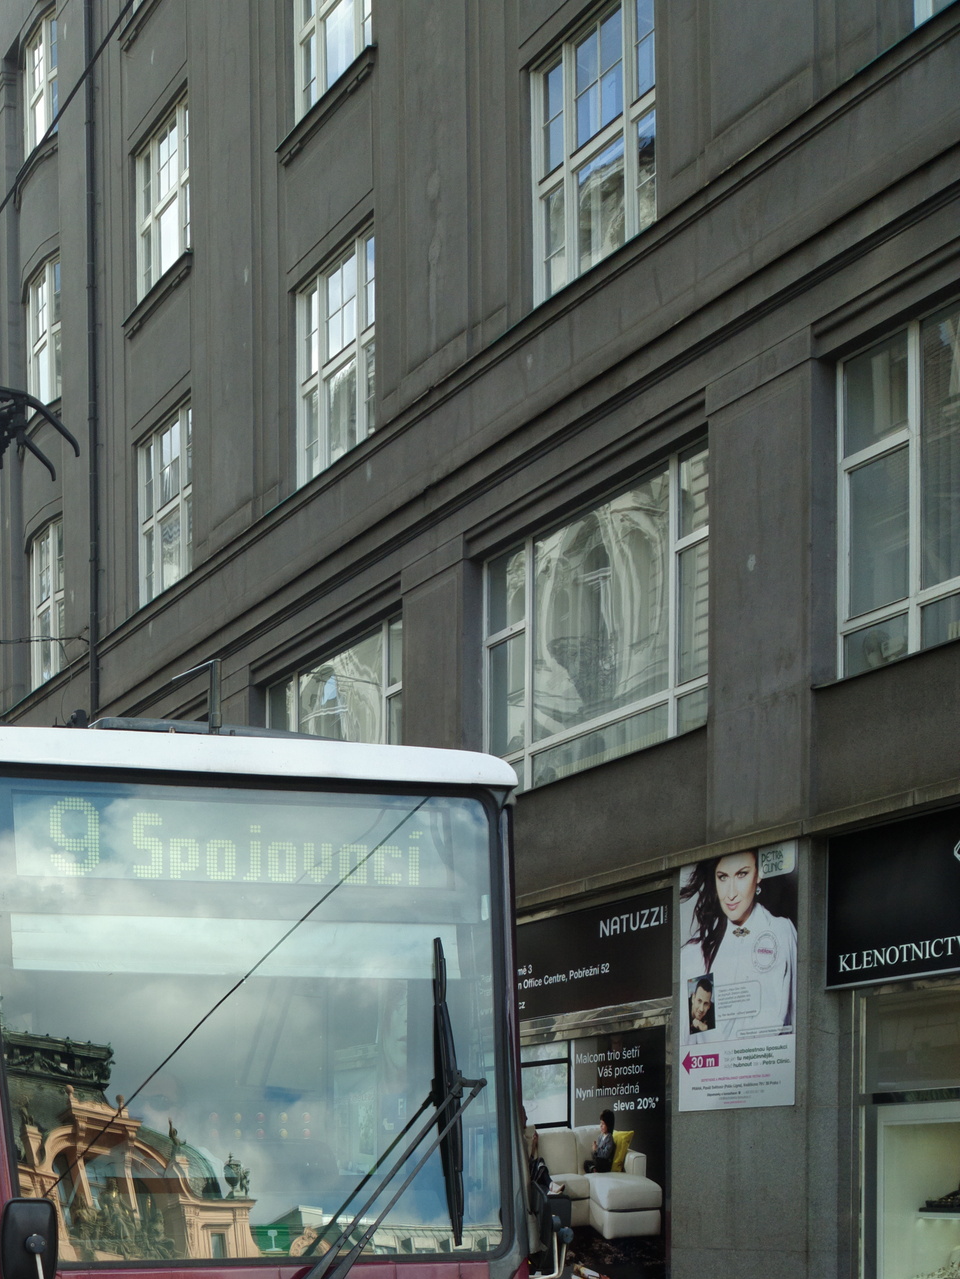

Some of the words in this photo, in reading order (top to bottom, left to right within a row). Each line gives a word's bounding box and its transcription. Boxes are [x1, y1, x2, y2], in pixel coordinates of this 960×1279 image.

[49, 797, 100, 876] 9
[133, 812, 424, 886] Spojovací
[761, 850, 784, 866] PETRA
[763, 860, 784, 874] CLINIC
[599, 906, 664, 938] NATUZZI
[523, 977, 543, 989] Office
[543, 973, 568, 985] Centre,
[569, 964, 600, 980] Pobřežní
[600, 962, 610, 974] 52
[527, 964, 533, 974] 3
[576, 1053, 606, 1064] Malcom
[607, 1050, 620, 1061] trio
[622, 1045, 641, 1060] šetří
[691, 1056, 704, 1069] 30
[705, 1057, 715, 1067] m
[597, 1065, 613, 1078] Váš
[614, 1064, 645, 1078] prostor.
[576, 1086, 594, 1101] Nyní
[595, 1082, 640, 1097] mimořádná
[613, 1100, 635, 1112] sleva
